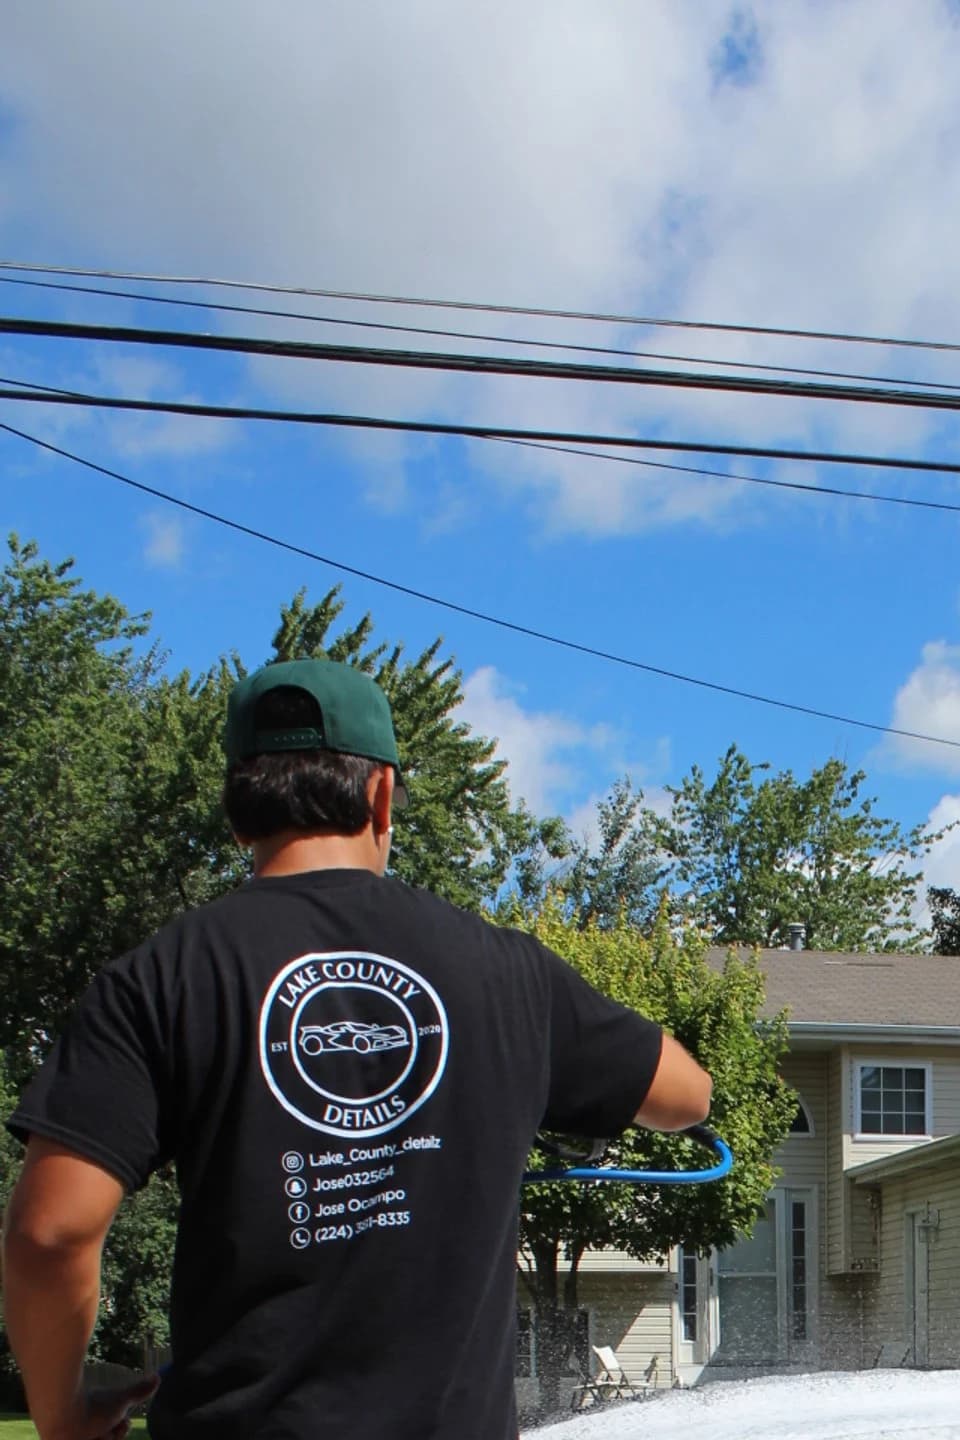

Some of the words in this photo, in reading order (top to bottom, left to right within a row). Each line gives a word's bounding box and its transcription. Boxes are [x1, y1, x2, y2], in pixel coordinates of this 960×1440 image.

[278, 966, 320, 1008] LAKE
[322, 962, 421, 1000] COUNTY
[271, 1042, 288, 1053] EST
[323, 1095, 406, 1128] DETAILS
[315, 1202, 345, 1217] Jose
[348, 1189, 406, 1212] Ocampo
[315, 1225, 353, 1243] (224)
